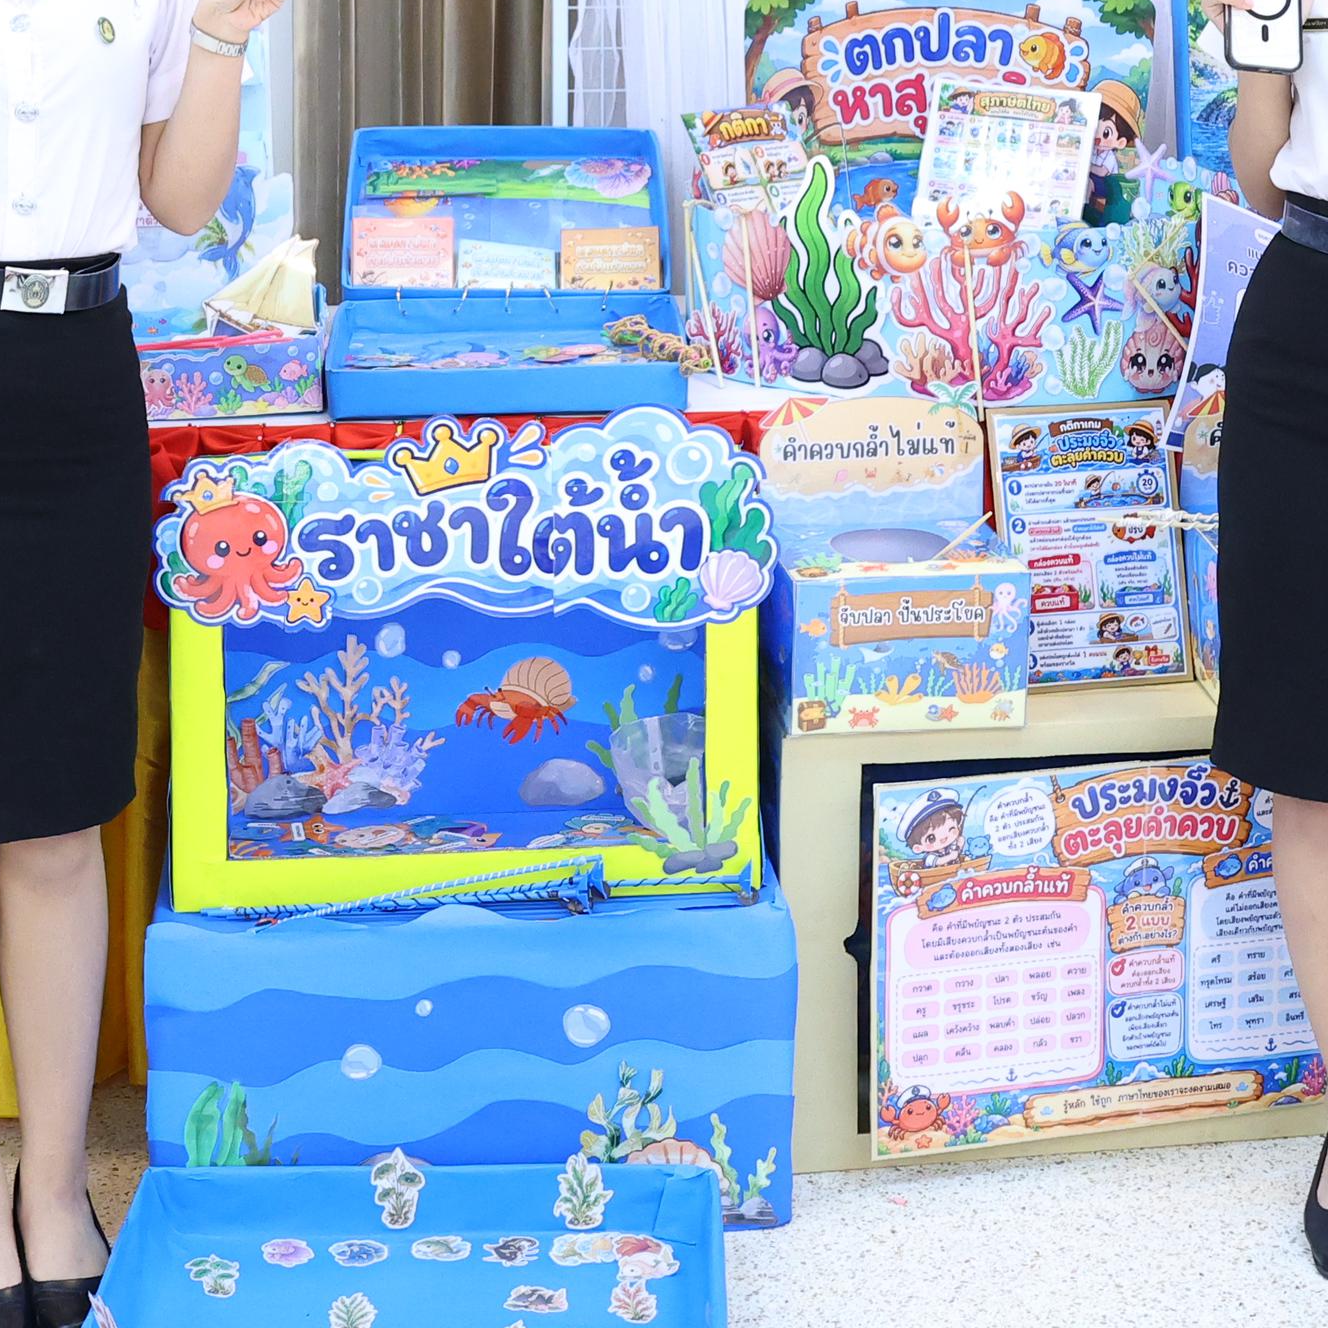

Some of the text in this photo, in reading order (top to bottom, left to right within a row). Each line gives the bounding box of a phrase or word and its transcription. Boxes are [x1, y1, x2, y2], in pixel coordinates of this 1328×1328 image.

[843, 13, 1014, 75] ตกปลา
[782, 421, 957, 462] คำควบกล้ำไม่แท้
[1142, 478, 1153, 487] 20
[298, 448, 705, 582] ราชาใต้น้ำ
[839, 597, 985, 626] จับปลา ปั้นประโยค
[1063, 806, 1238, 854] ตะลุยคำควบ
[961, 866, 1072, 903] คำควบกล้ำแท้
[1225, 888, 1277, 901] คือ คำที่มีพยัญช
[1225, 900, 1279, 913] แต่ไม่ออกเสียงค
[931, 921, 944, 933] คือ
[946, 916, 1002, 931] คำที่มีพยัญชนะ
[1012, 914, 1023, 923] ตัว
[1025, 909, 1062, 923] ประสมกัน
[1125, 915, 1171, 932] 2 แบบ
[1046, 939, 1062, 950] เช่น
[1246, 950, 1267, 960] ทราย
[994, 973, 1010, 984] ปลา
[1028, 969, 1052, 980] พลอย
[1066, 966, 1088, 976] ควาย
[915, 1005, 927, 1018] ครู
[1065, 1010, 1086, 1022] ปลวก
[1244, 1017, 1265, 1029] พุทรา
[912, 1052, 930, 1066] ปลูก
[1090, 1093, 1113, 1109] ใช้ถูก
